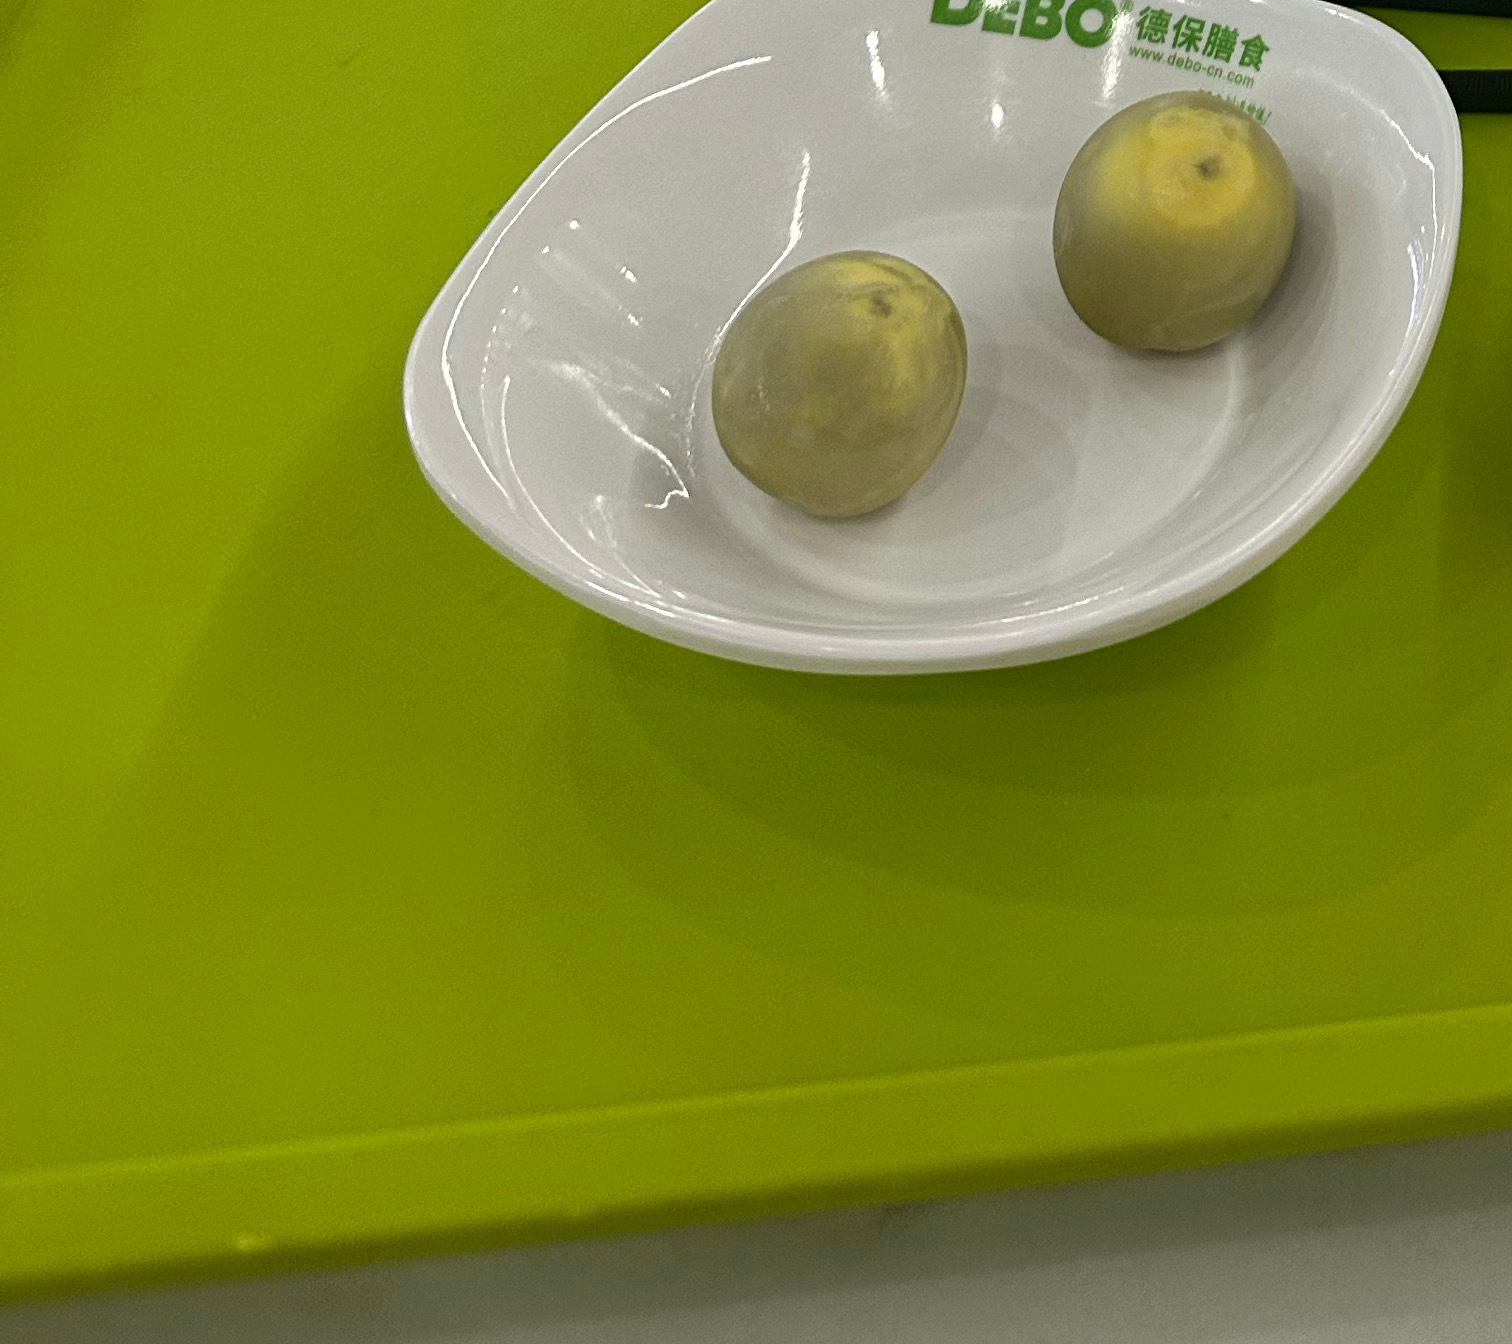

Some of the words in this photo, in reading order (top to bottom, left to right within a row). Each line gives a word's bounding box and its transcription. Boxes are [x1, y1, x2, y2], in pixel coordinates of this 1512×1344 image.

[1136, 6, 1270, 71] 德保膳食
[1129, 46, 1255, 89] www.debo-cn.com
